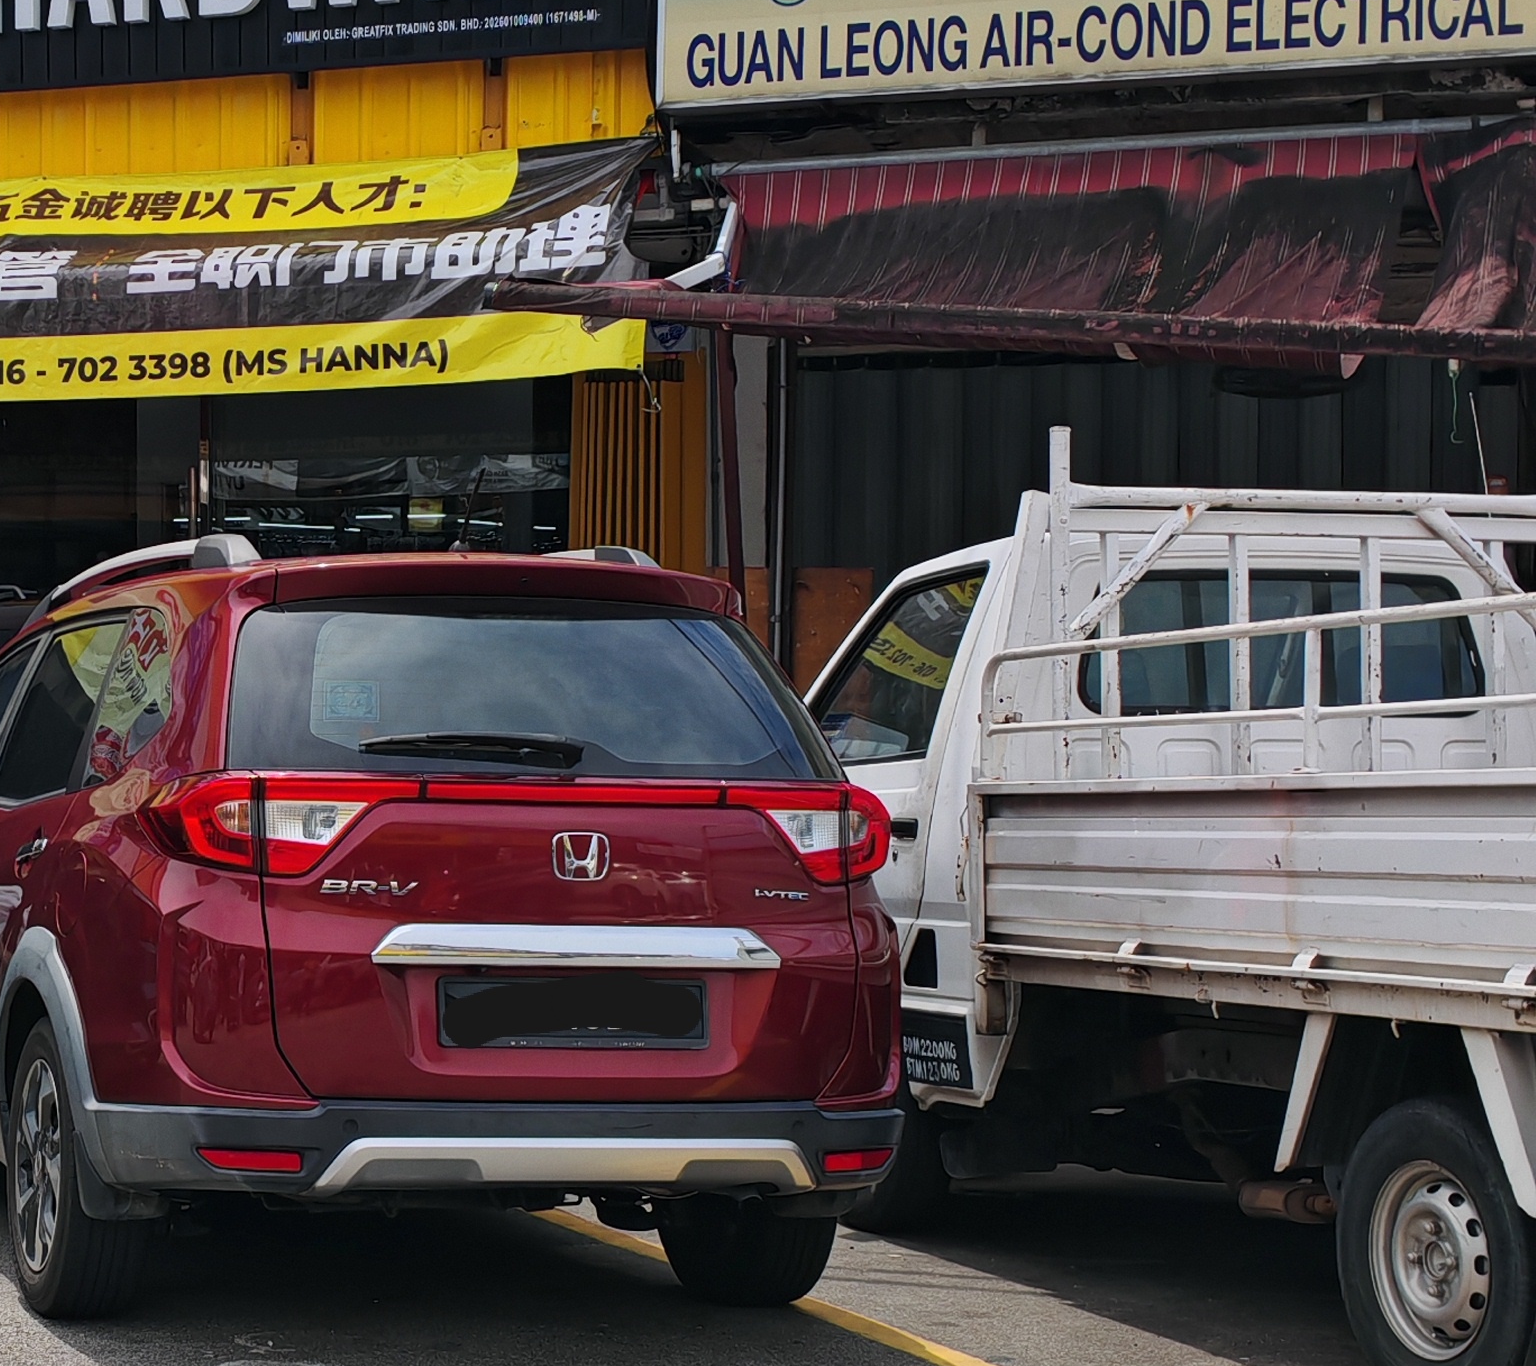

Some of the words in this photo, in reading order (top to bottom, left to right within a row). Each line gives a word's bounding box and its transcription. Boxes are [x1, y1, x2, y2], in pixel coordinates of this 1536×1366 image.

[351, 25, 394, 38] GREATFIX
[396, 22, 435, 35] TRADING
[437, 20, 458, 32] SDN.
[686, 26, 805, 89] GUAN
[819, 16, 968, 79] LEONG
[57, 355, 119, 383] 702
[128, 351, 211, 381] 3398
[223, 348, 288, 383] (MS
[299, 339, 449, 374] HANNA)
[320, 879, 419, 896] BR-V
